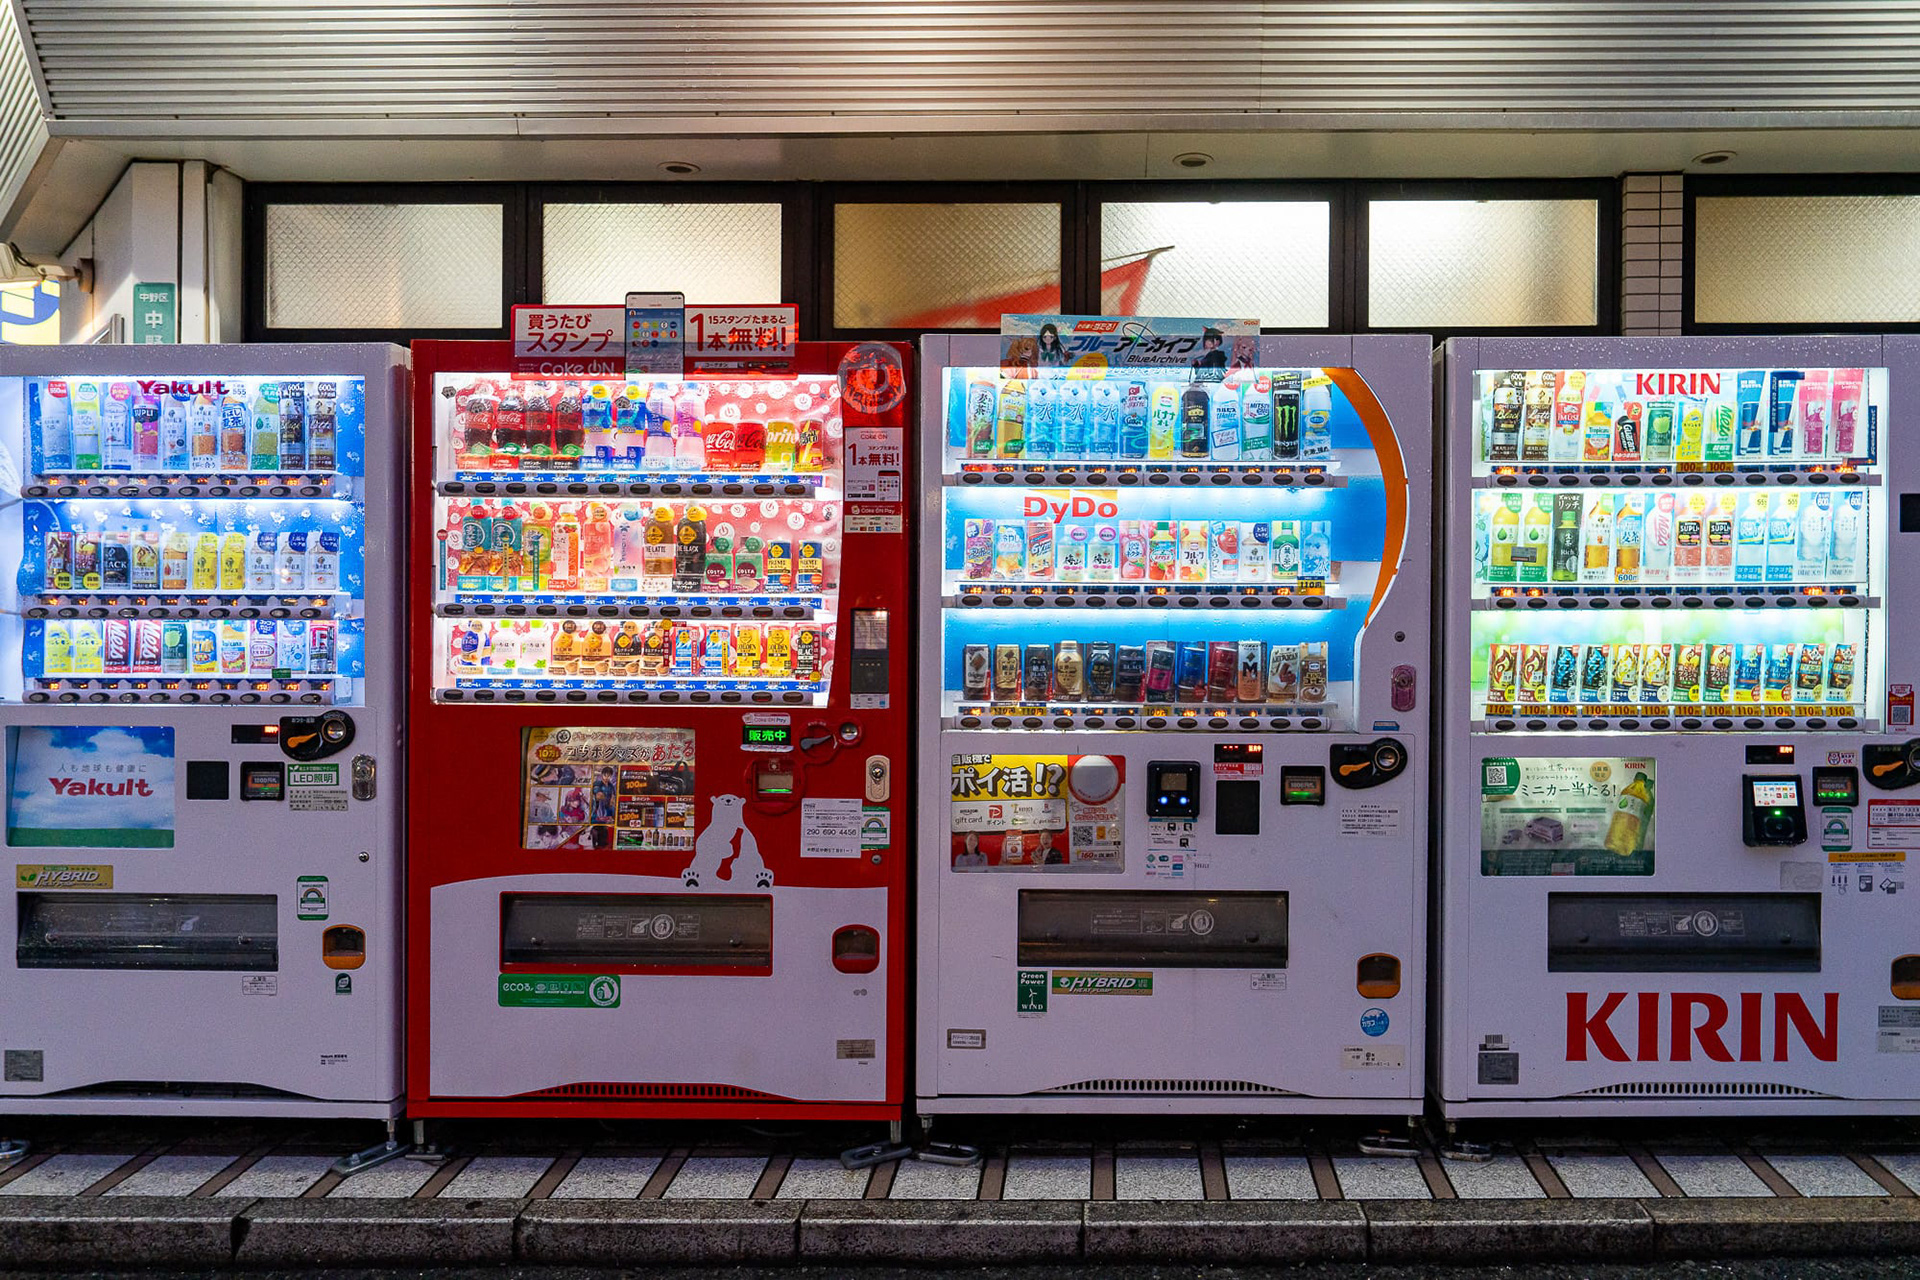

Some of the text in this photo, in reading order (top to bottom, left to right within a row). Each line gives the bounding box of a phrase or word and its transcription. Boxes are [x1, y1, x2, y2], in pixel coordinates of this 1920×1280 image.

[139, 292, 169, 302] 中野区
[528, 313, 592, 330] 買うたび
[708, 315, 787, 324] 15スタンプたまると
[526, 329, 613, 352] スタンプ
[1067, 335, 1200, 354] ブルーアーカイブ
[539, 362, 584, 377] Coke
[137, 380, 230, 395] Yakult
[1636, 373, 1720, 395] KIRIN
[1023, 496, 1118, 524] DyDo
[748, 729, 787, 742] 販売中
[952, 754, 991, 765] 自販機で
[58, 764, 147, 774] 人も地球も健康に
[293, 773, 333, 784] LED照明
[48, 777, 154, 797] Yakult
[1520, 782, 1618, 798] ミニカー当たる!
[969, 816, 983, 824] card
[35, 871, 99, 886] HYBRID
[1070, 977, 1137, 992] HYBRID
[1567, 993, 1839, 1062] KIRIN
